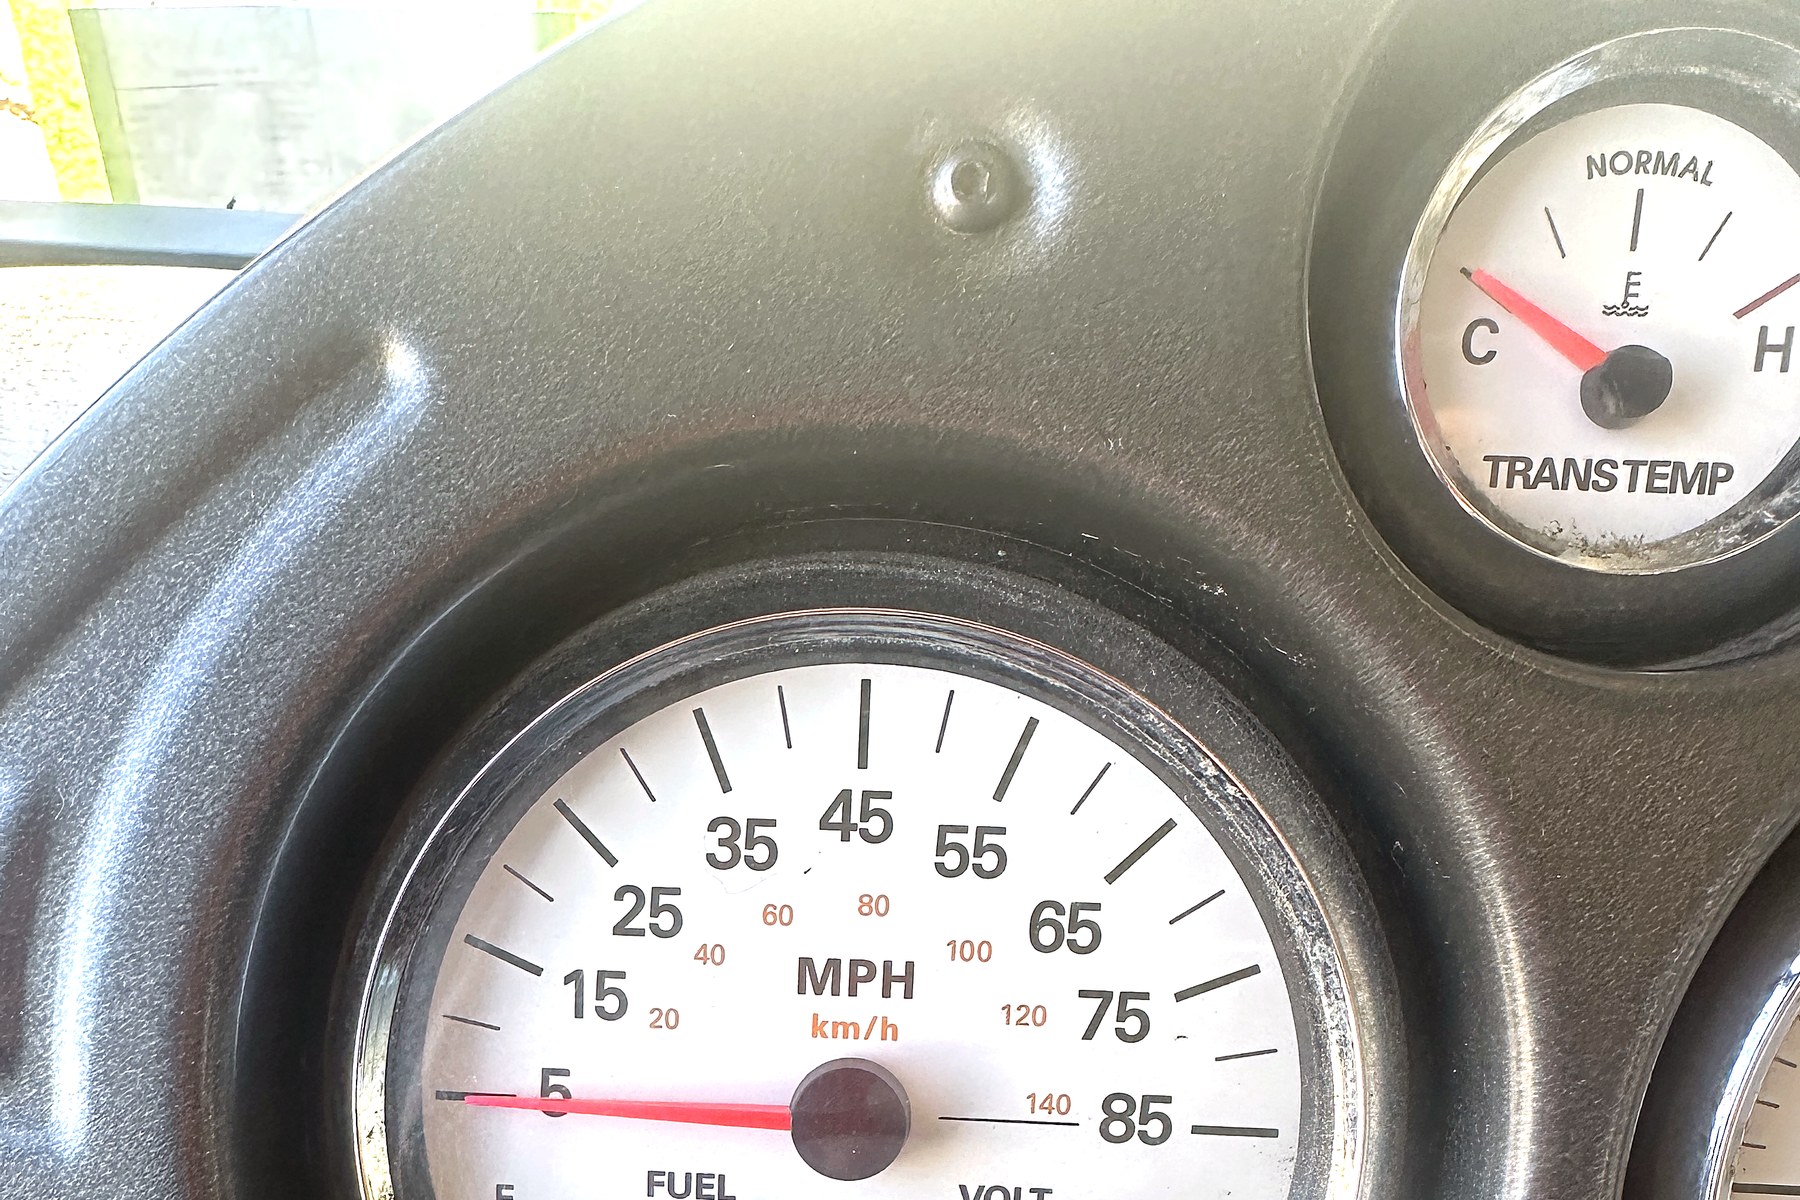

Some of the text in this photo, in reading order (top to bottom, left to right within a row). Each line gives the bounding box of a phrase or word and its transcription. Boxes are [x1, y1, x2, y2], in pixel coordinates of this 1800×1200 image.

[1587, 150, 1714, 186] NORMAL
[1461, 318, 1500, 365] C
[1753, 325, 1795, 373] H
[819, 789, 894, 844] 45
[705, 816, 778, 871] 35
[934, 824, 1008, 879] 55
[612, 884, 684, 939] 25
[762, 904, 794, 927] 60
[857, 894, 890, 917] 80
[1029, 900, 1102, 955] 65
[693, 943, 726, 966] 40
[946, 940, 993, 963] 100
[563, 969, 628, 1021] 15
[797, 956, 915, 1000] MPH
[649, 1007, 680, 1030] 20
[811, 1013, 899, 1042] km/h
[1001, 1004, 1048, 1027] 120
[1078, 989, 1151, 1043] 75
[540, 1067, 572, 1118] 5
[1026, 1093, 1071, 1116] 140
[1099, 1092, 1173, 1146] 85
